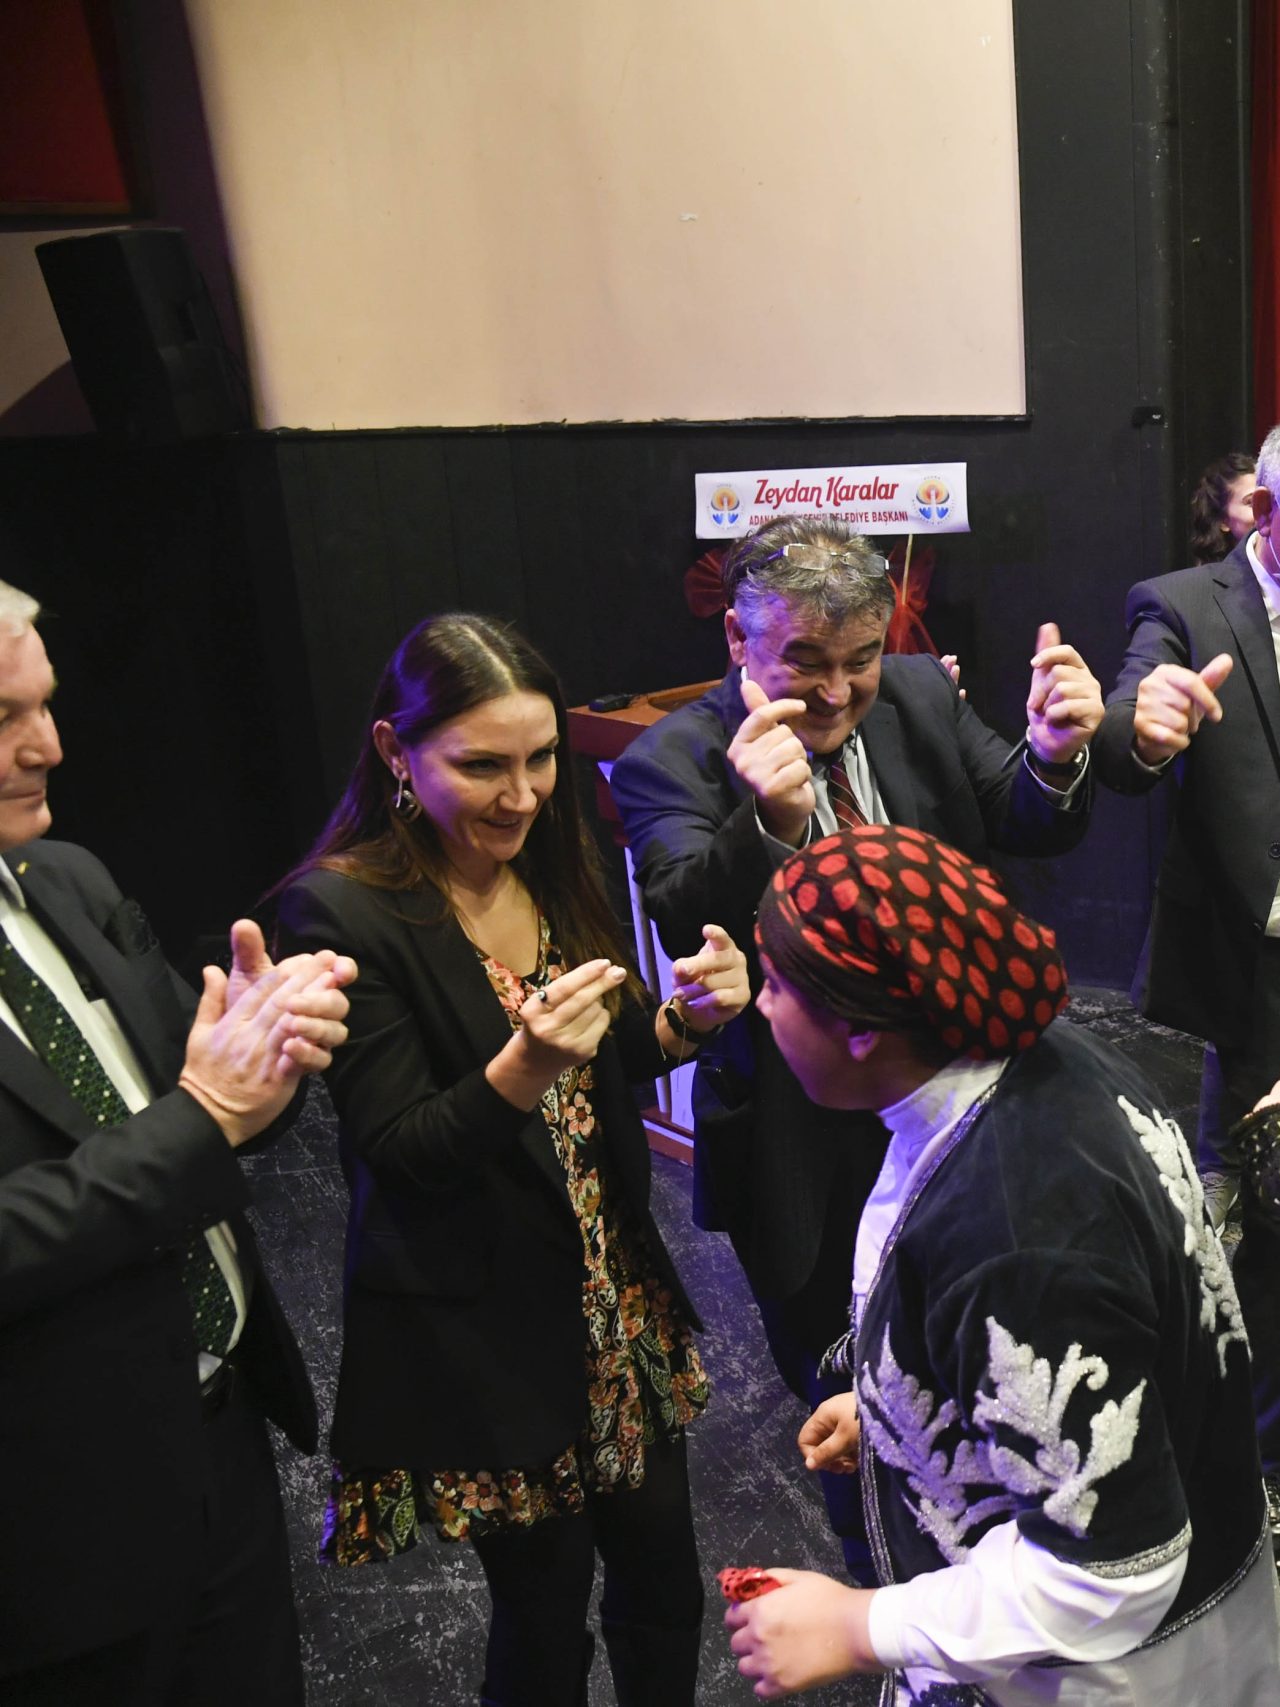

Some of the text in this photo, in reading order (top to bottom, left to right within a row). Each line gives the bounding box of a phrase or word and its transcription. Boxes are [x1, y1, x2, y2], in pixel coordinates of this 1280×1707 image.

[754, 479, 822, 510] Zeydan
[826, 475, 900, 507] Karalar
[872, 511, 909, 526] BAŞKANI
